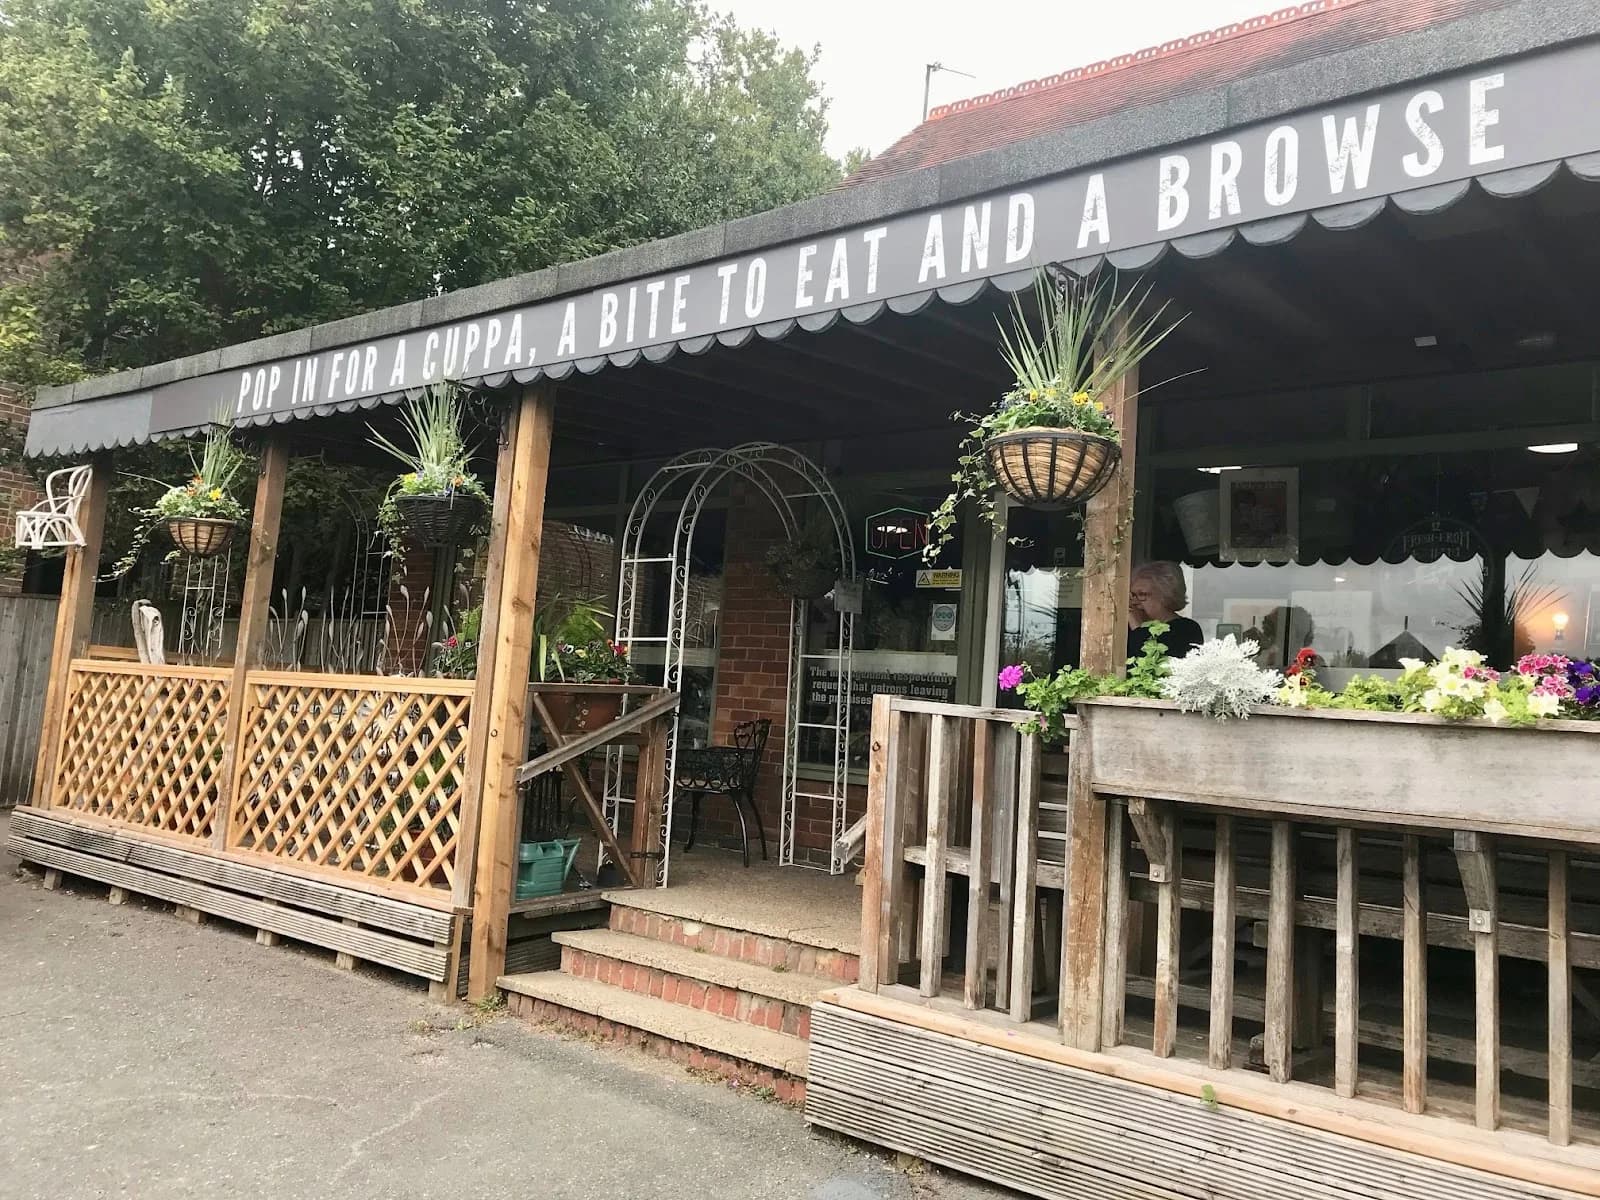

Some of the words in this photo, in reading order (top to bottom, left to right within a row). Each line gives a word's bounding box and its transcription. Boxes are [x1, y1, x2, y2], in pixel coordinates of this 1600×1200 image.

[236, 366, 281, 414] POP
[291, 358, 319, 405] IN
[327, 346, 378, 399] FOR
[388, 339, 406, 387] A
[422, 313, 537, 381] CUPPA,
[556, 302, 576, 357] A
[598, 274, 691, 349] BITE
[717, 257, 767, 325] TO
[794, 226, 888, 309] EAT
[917, 192, 1035, 284] AND
[1076, 173, 1111, 249] A
[1156, 72, 1505, 232] BROWSE
[871, 518, 929, 550] OPEN
[809, 666, 828, 677] The
[830, 669, 890, 682] magement
[811, 691, 828, 702] the
[829, 693, 874, 706] prmises
[870, 682, 907, 695] patrons
[909, 684, 949, 699] leaving
